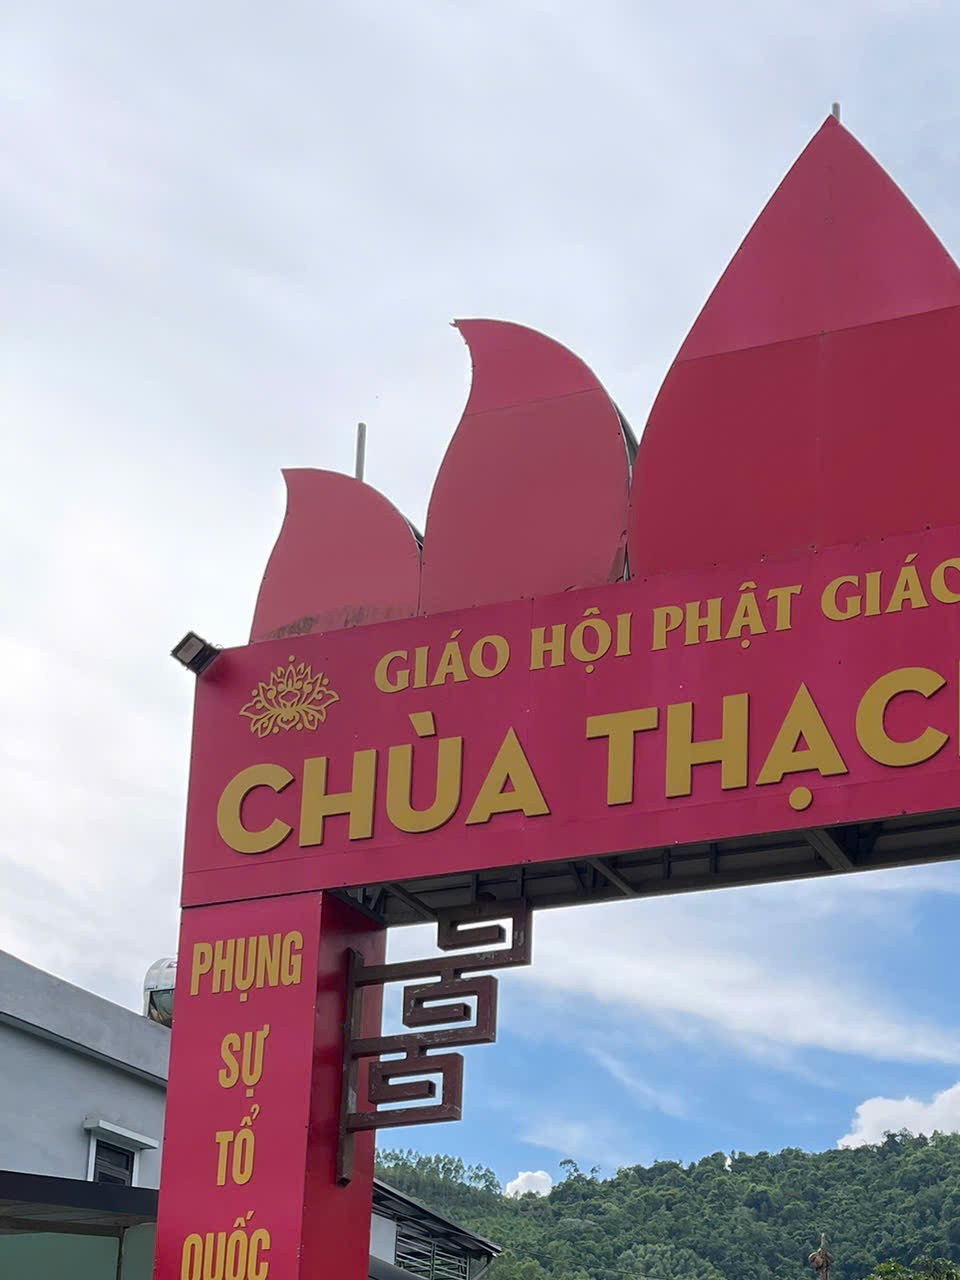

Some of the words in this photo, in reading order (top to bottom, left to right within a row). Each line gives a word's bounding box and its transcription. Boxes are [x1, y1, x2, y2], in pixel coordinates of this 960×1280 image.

[375, 629, 510, 693] GIÁO
[531, 608, 632, 674] HỘI
[653, 581, 802, 651] PHẬT
[217, 711, 549, 853] CHÙA
[190, 930, 304, 1003] PHỤNG
[218, 1024, 270, 1097] SỰ
[215, 1103, 260, 1186] TỔ
